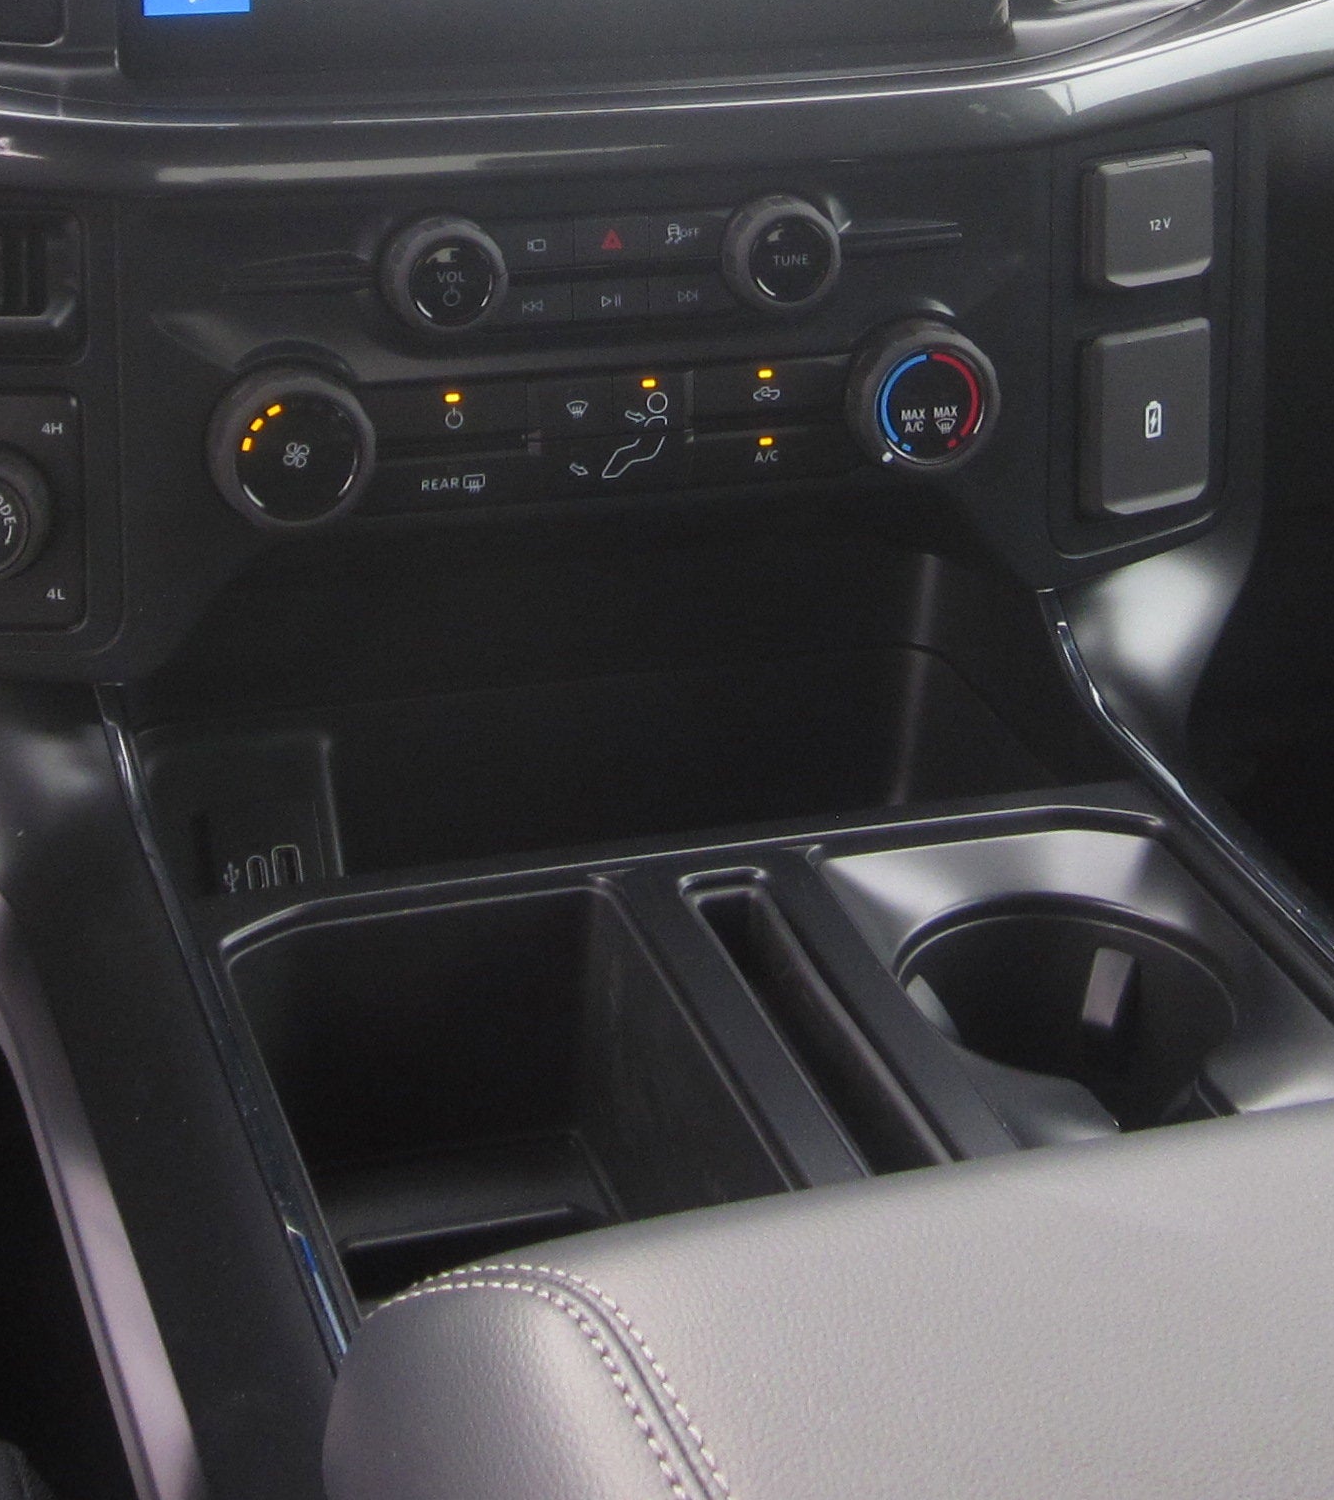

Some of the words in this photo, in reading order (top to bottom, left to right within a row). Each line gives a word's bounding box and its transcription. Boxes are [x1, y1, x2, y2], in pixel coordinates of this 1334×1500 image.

[681, 227, 700, 238] OFF
[772, 253, 810, 267] TUNE
[436, 271, 466, 285] VOL
[901, 409, 926, 421] MAX
[933, 406, 959, 418] MAX
[41, 422, 63, 435] 4H
[904, 421, 925, 433] A/C
[754, 449, 779, 464] A/C
[421, 476, 460, 492] REAR
[45, 587, 67, 600] 4L
